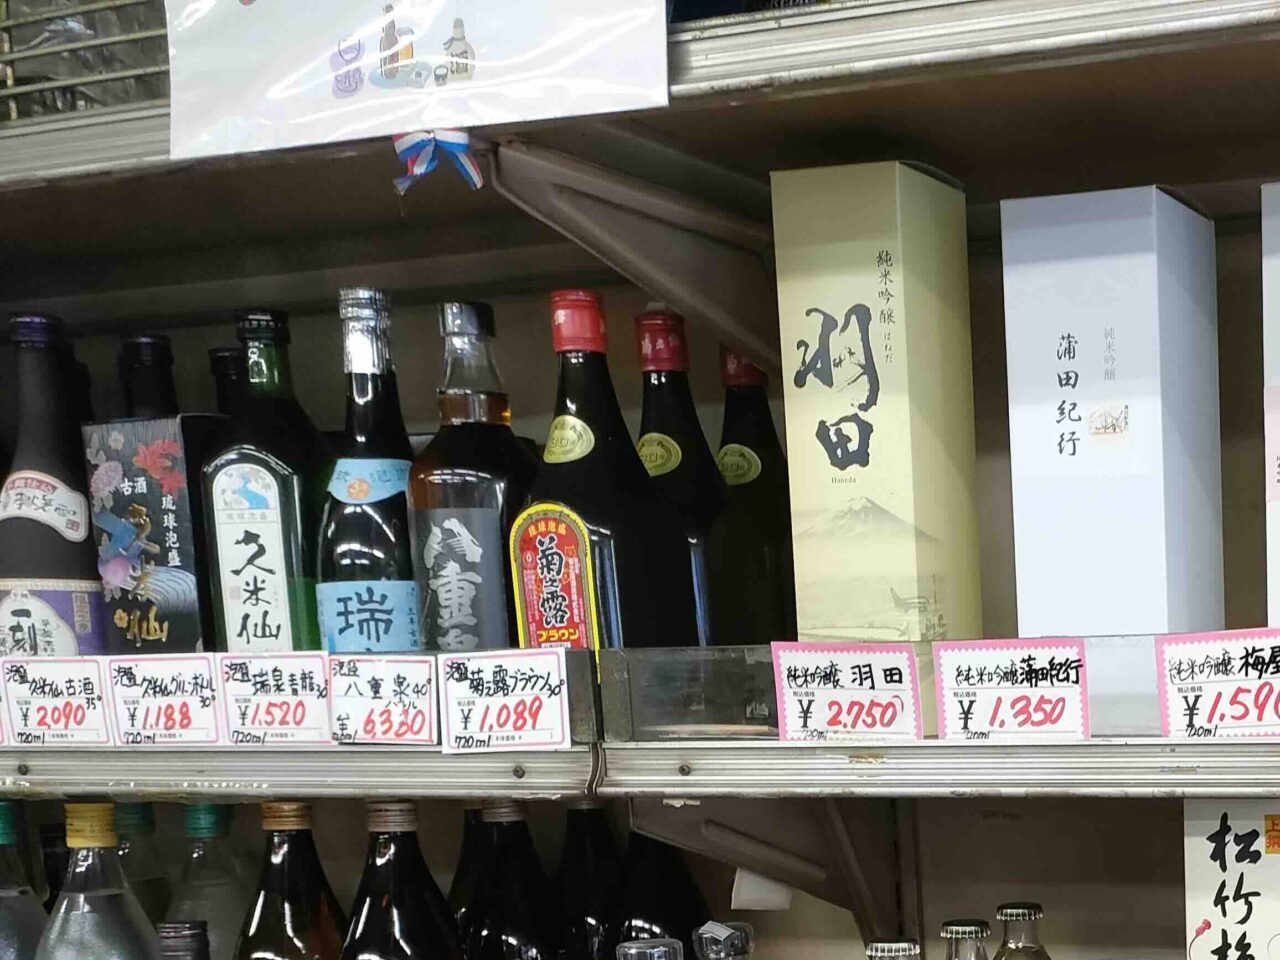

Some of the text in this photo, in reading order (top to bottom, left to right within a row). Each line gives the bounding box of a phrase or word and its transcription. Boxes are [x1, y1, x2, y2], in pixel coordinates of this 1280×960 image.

[876, 249, 896, 325] 純米吟醸
[1056, 333, 1082, 456] 蒲田紀行
[120, 477, 147, 496] 古酒
[161, 496, 181, 567] 琉球泡盛
[230, 530, 281, 644] 久米仙
[536, 534, 569, 628] 菊之露
[537, 629, 579, 641] ブラウン
